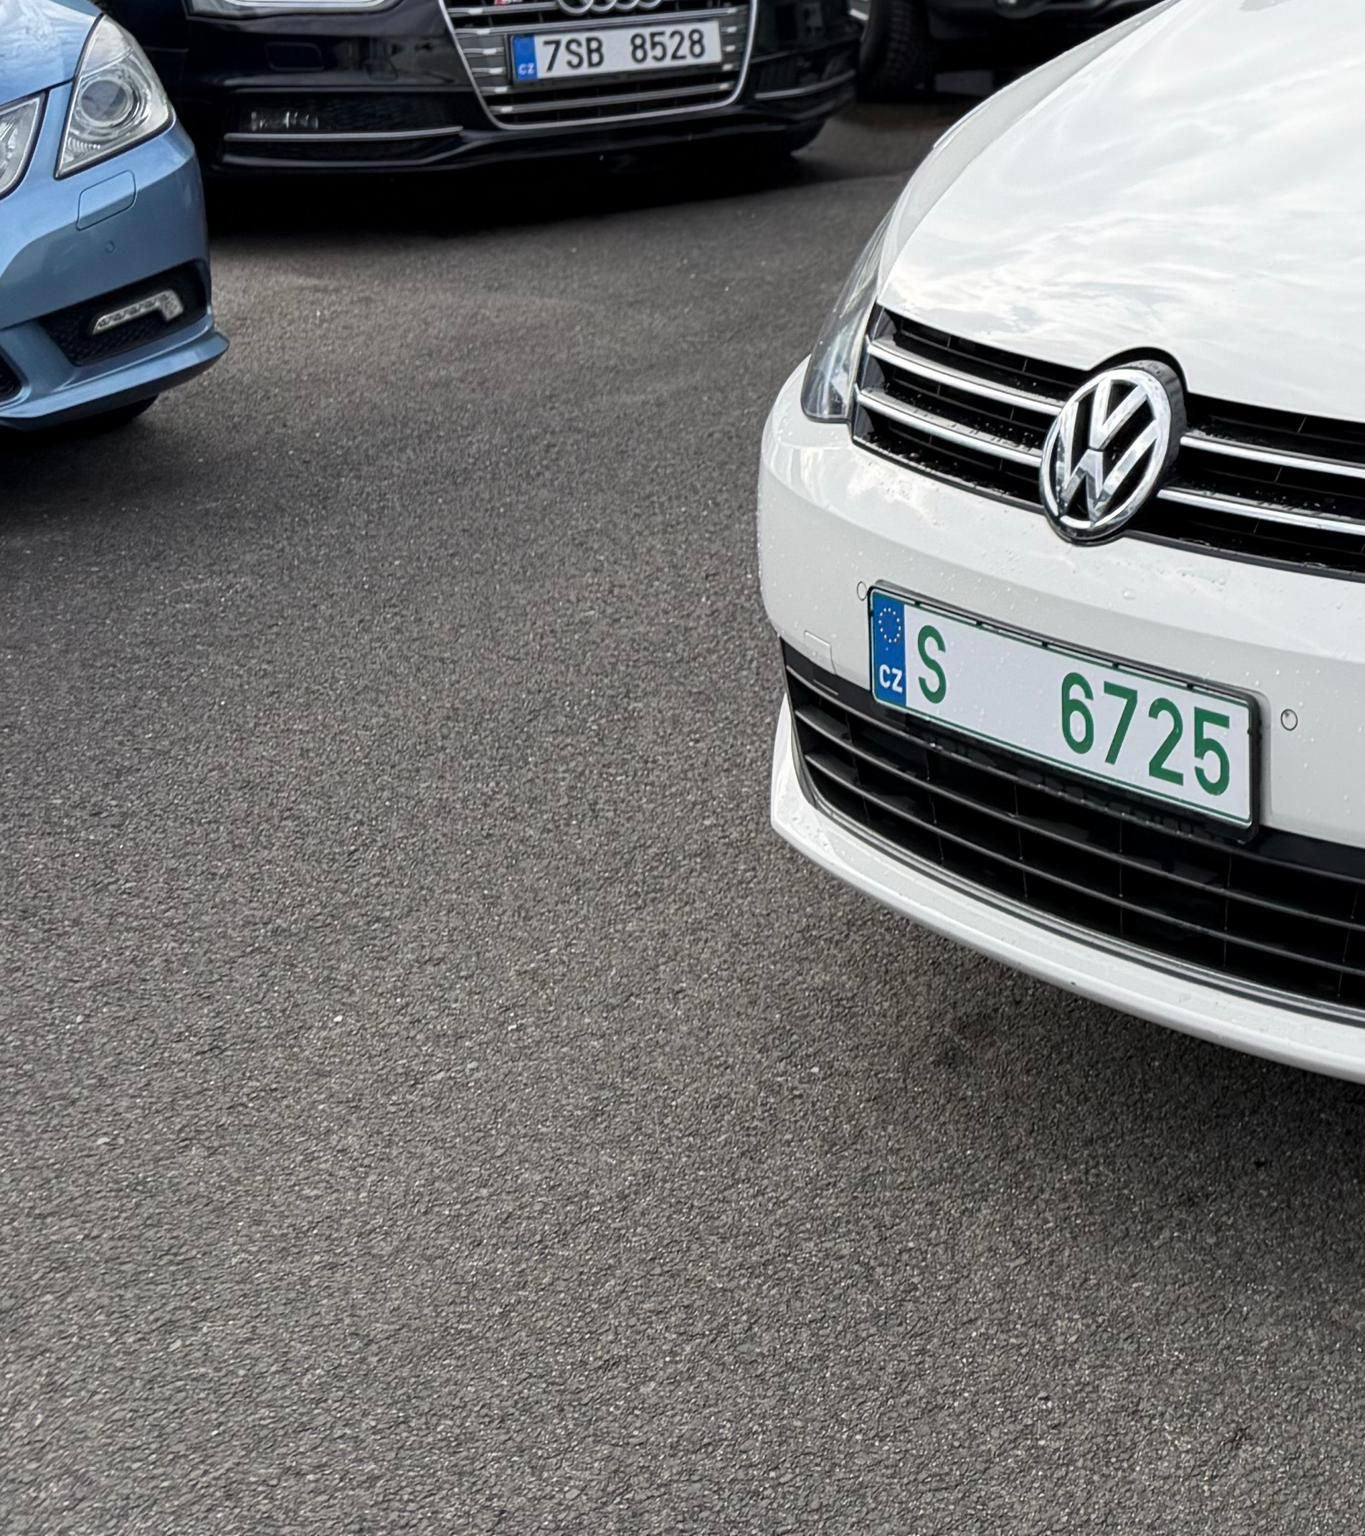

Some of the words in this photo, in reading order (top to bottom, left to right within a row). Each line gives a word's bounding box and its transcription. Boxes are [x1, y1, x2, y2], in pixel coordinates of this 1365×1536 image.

[542, 36, 605, 73] 7SB
[630, 28, 706, 64] 8528
[879, 663, 904, 693] CZ
[917, 624, 947, 704] S
[1061, 671, 1231, 796] 6725
